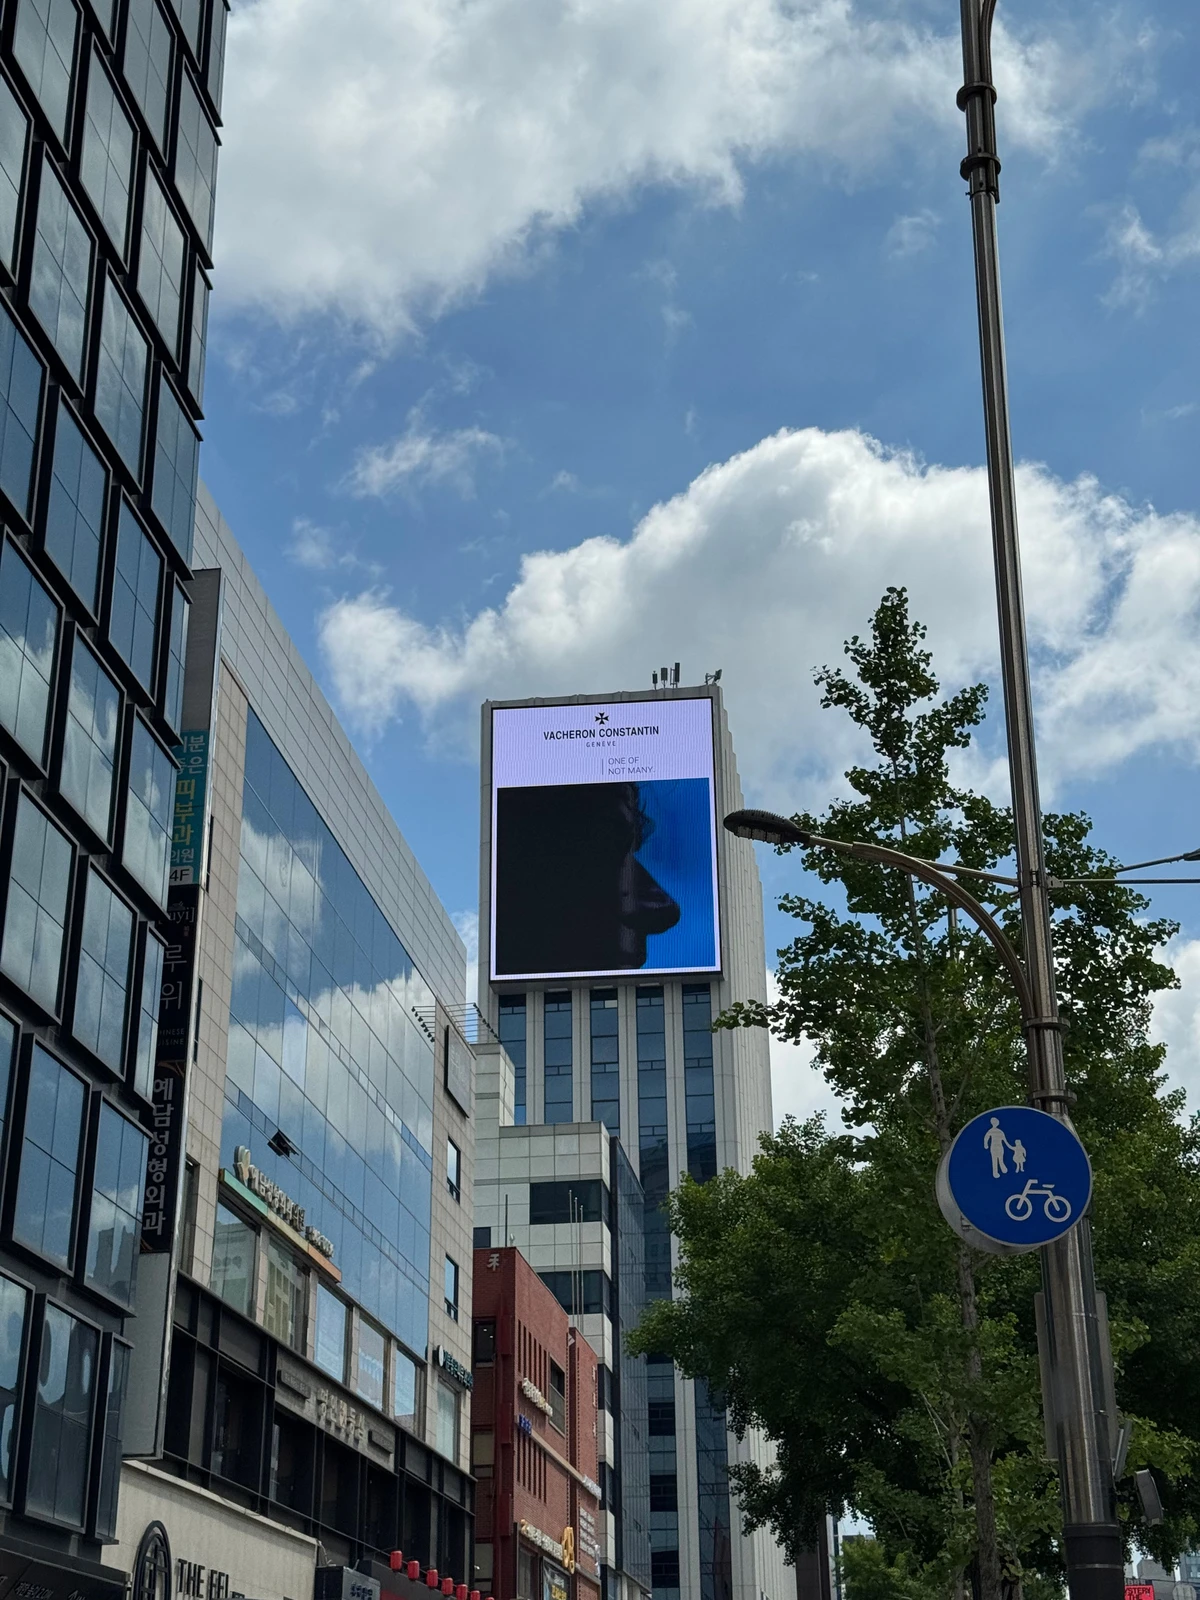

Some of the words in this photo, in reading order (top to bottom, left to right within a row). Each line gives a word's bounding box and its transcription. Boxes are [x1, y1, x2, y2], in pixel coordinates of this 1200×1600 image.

[543, 729, 596, 741] VACHERON
[598, 726, 659, 738] CONSTANTIN
[608, 757, 627, 765] ONE
[628, 756, 640, 764] OF
[608, 767, 626, 775] NOT
[170, 868, 190, 882] 4F
[143, 1077, 174, 1236] 예담성형외과
[177, 1558, 206, 1599] THE
